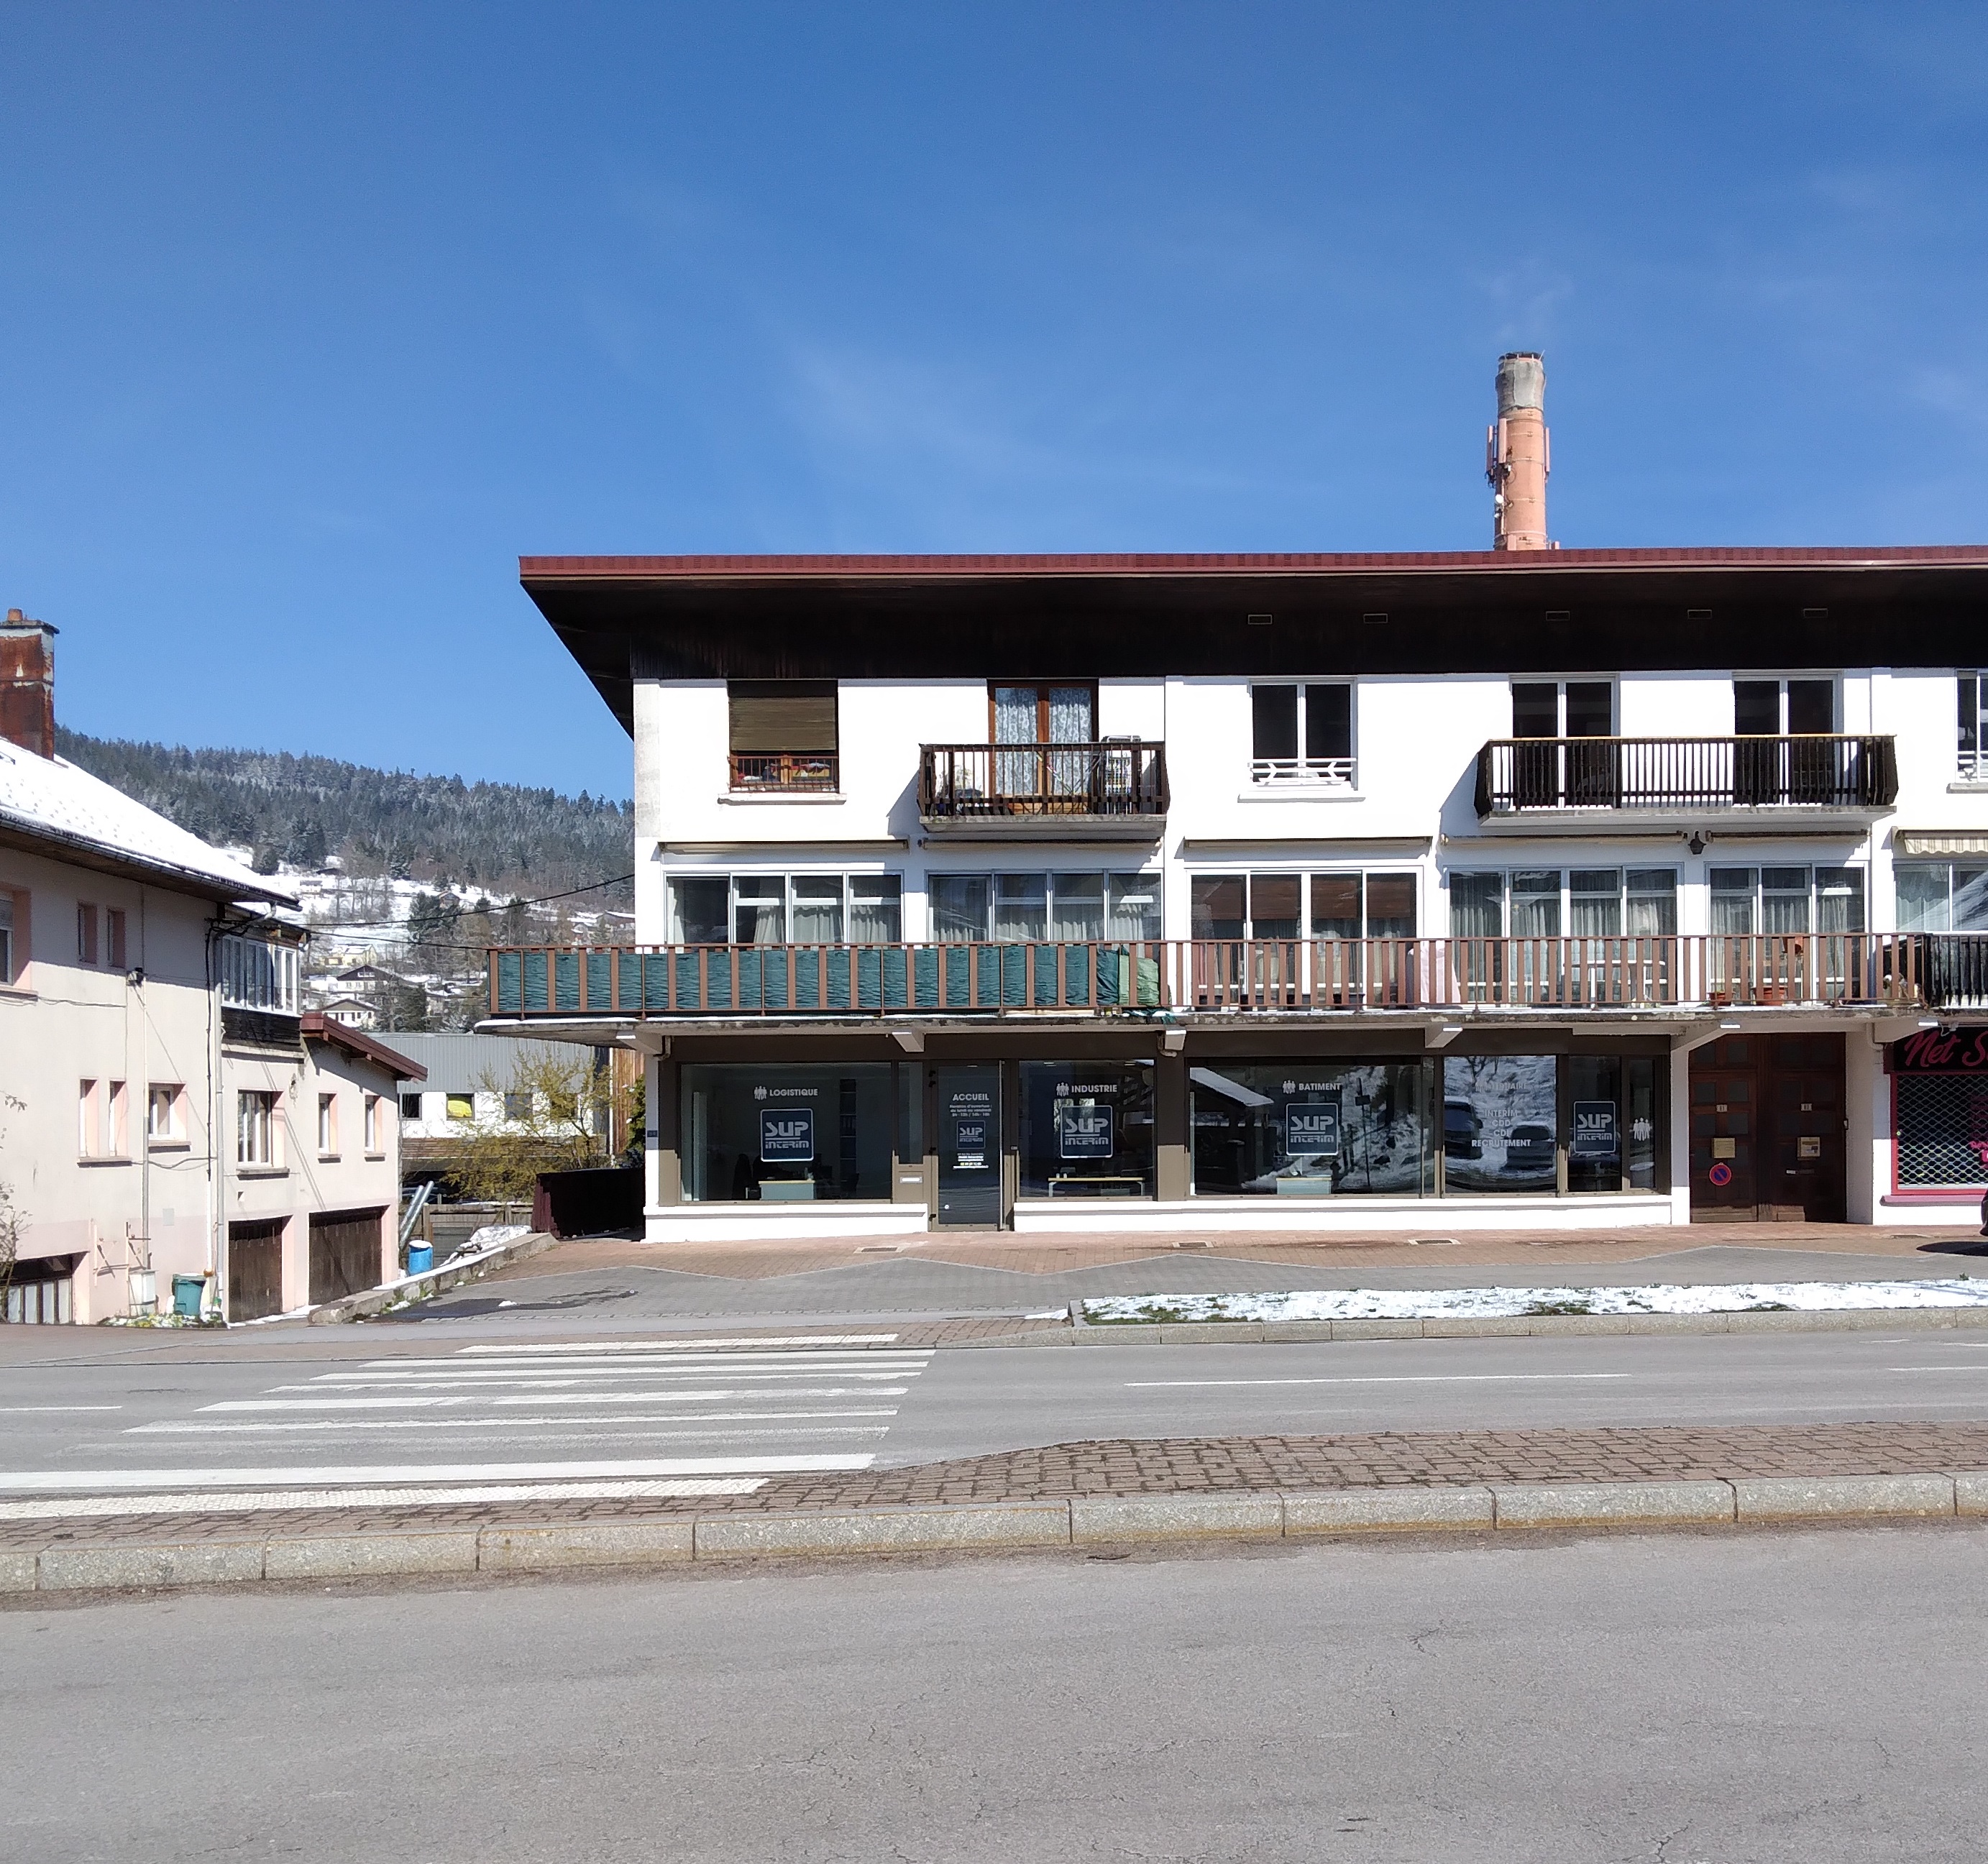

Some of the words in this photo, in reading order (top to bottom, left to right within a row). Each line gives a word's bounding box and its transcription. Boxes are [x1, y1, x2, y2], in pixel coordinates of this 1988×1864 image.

[1904, 1031, 1961, 1068] Net
[769, 1088, 818, 1097] LOGISTIQUE
[1071, 1084, 1117, 1093] INDUSTRIE
[952, 1093, 989, 1101] ACCUEIL
[765, 1121, 809, 1137] SUP
[1065, 1118, 1109, 1133] SUP
[1290, 1115, 1334, 1131] SUP
[1577, 1114, 1612, 1129] SUP
[1471, 1139, 1531, 1147] RECRUTEMENT
